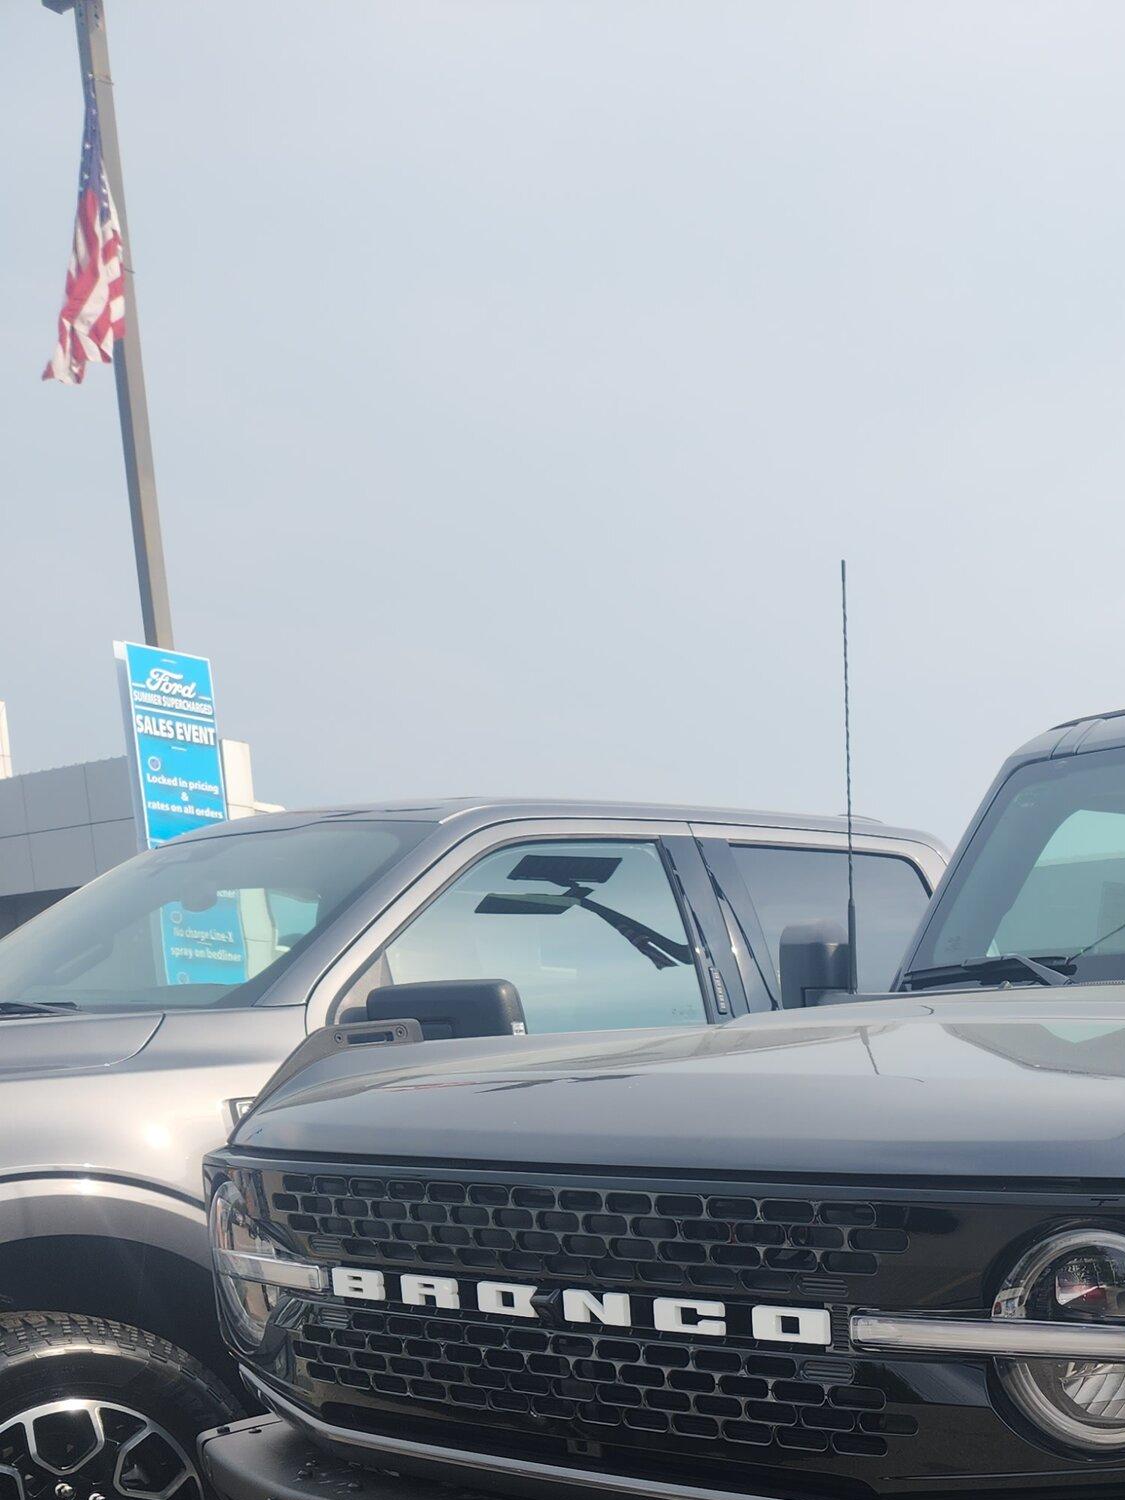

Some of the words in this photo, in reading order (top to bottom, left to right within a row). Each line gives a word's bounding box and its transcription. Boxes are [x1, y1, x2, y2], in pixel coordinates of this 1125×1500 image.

[146, 668, 197, 698] Ford
[133, 690, 162, 706] SUMMER
[162, 696, 213, 716] SUPERCHARGED
[135, 714, 175, 739] SALES
[175, 720, 216, 746] EVENT
[146, 773, 178, 787] Locked
[178, 777, 188, 788] in
[188, 781, 219, 795] pricing
[180, 791, 189, 802] &
[147, 801, 170, 811] rates
[170, 804, 183, 813] on
[183, 805, 195, 815] all
[195, 807, 224, 819] orders
[332, 1266, 831, 1345] BRONCO
